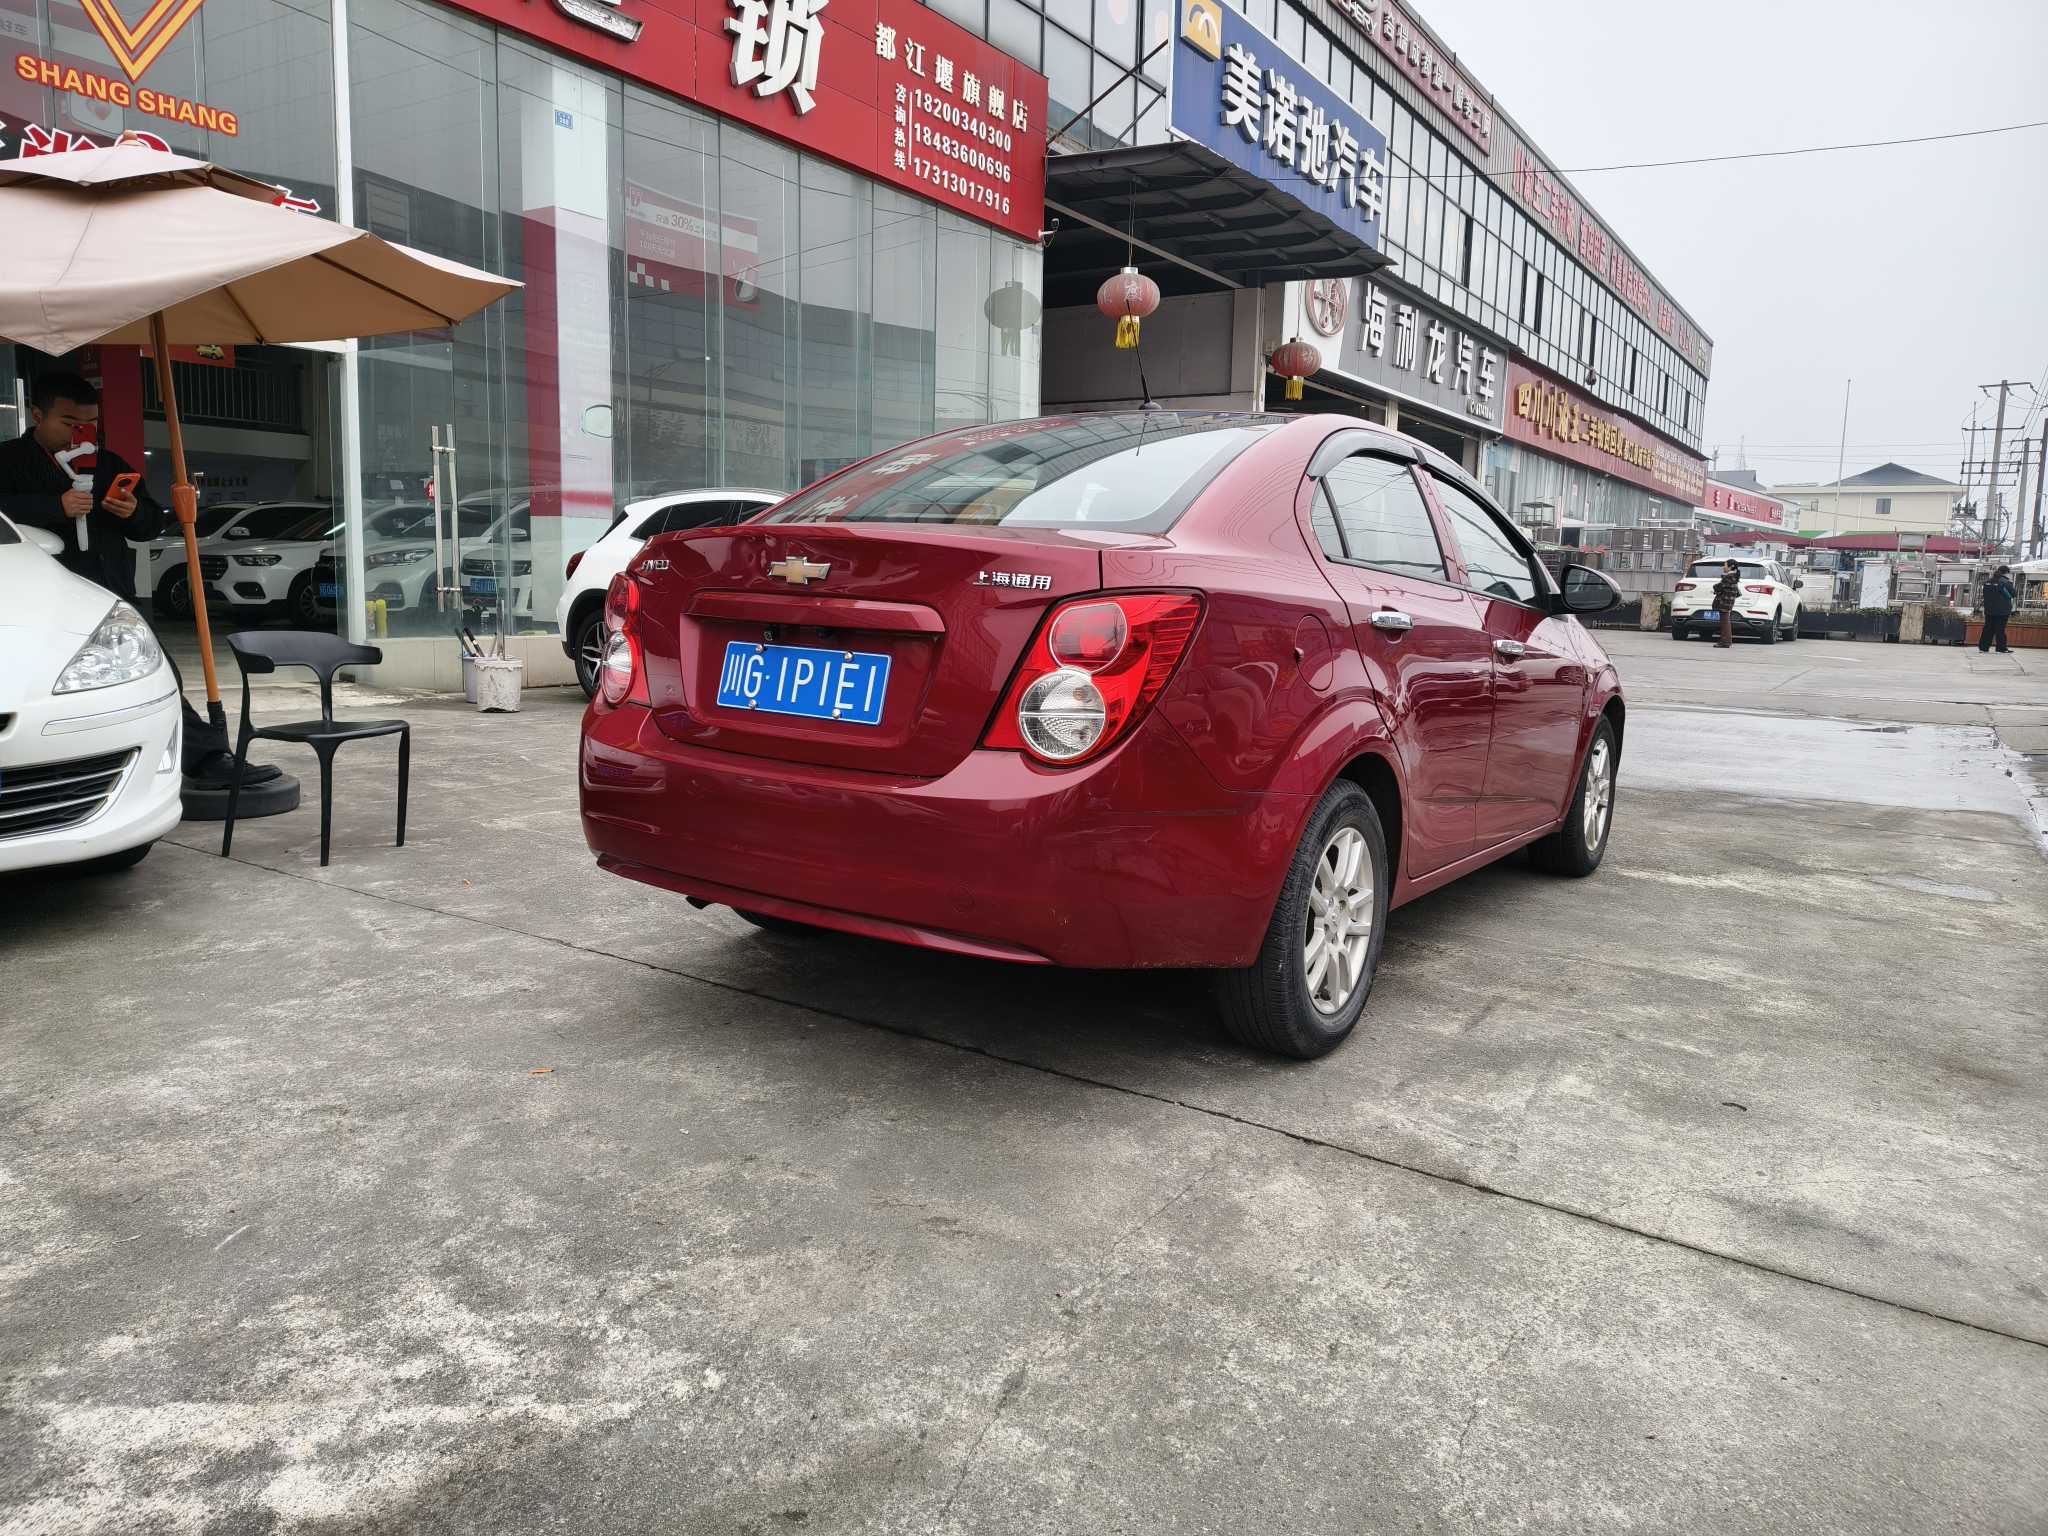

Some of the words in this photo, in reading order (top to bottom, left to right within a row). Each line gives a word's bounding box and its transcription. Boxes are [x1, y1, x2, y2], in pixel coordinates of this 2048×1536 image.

[16, 55, 131, 107] SHANG
[136, 88, 238, 136] SHANG
[875, 21, 1029, 132] 都江堰旗舰店
[894, 82, 907, 171] 咨询热线
[914, 87, 1012, 153] 18200340300
[914, 121, 1012, 184] 18483600696
[1220, 43, 1385, 222] 美诺弛汽车
[913, 156, 1011, 215] 17313017916
[1362, 280, 1497, 402] 海利龙汽车
[972, 570, 1052, 590] 上海通用
